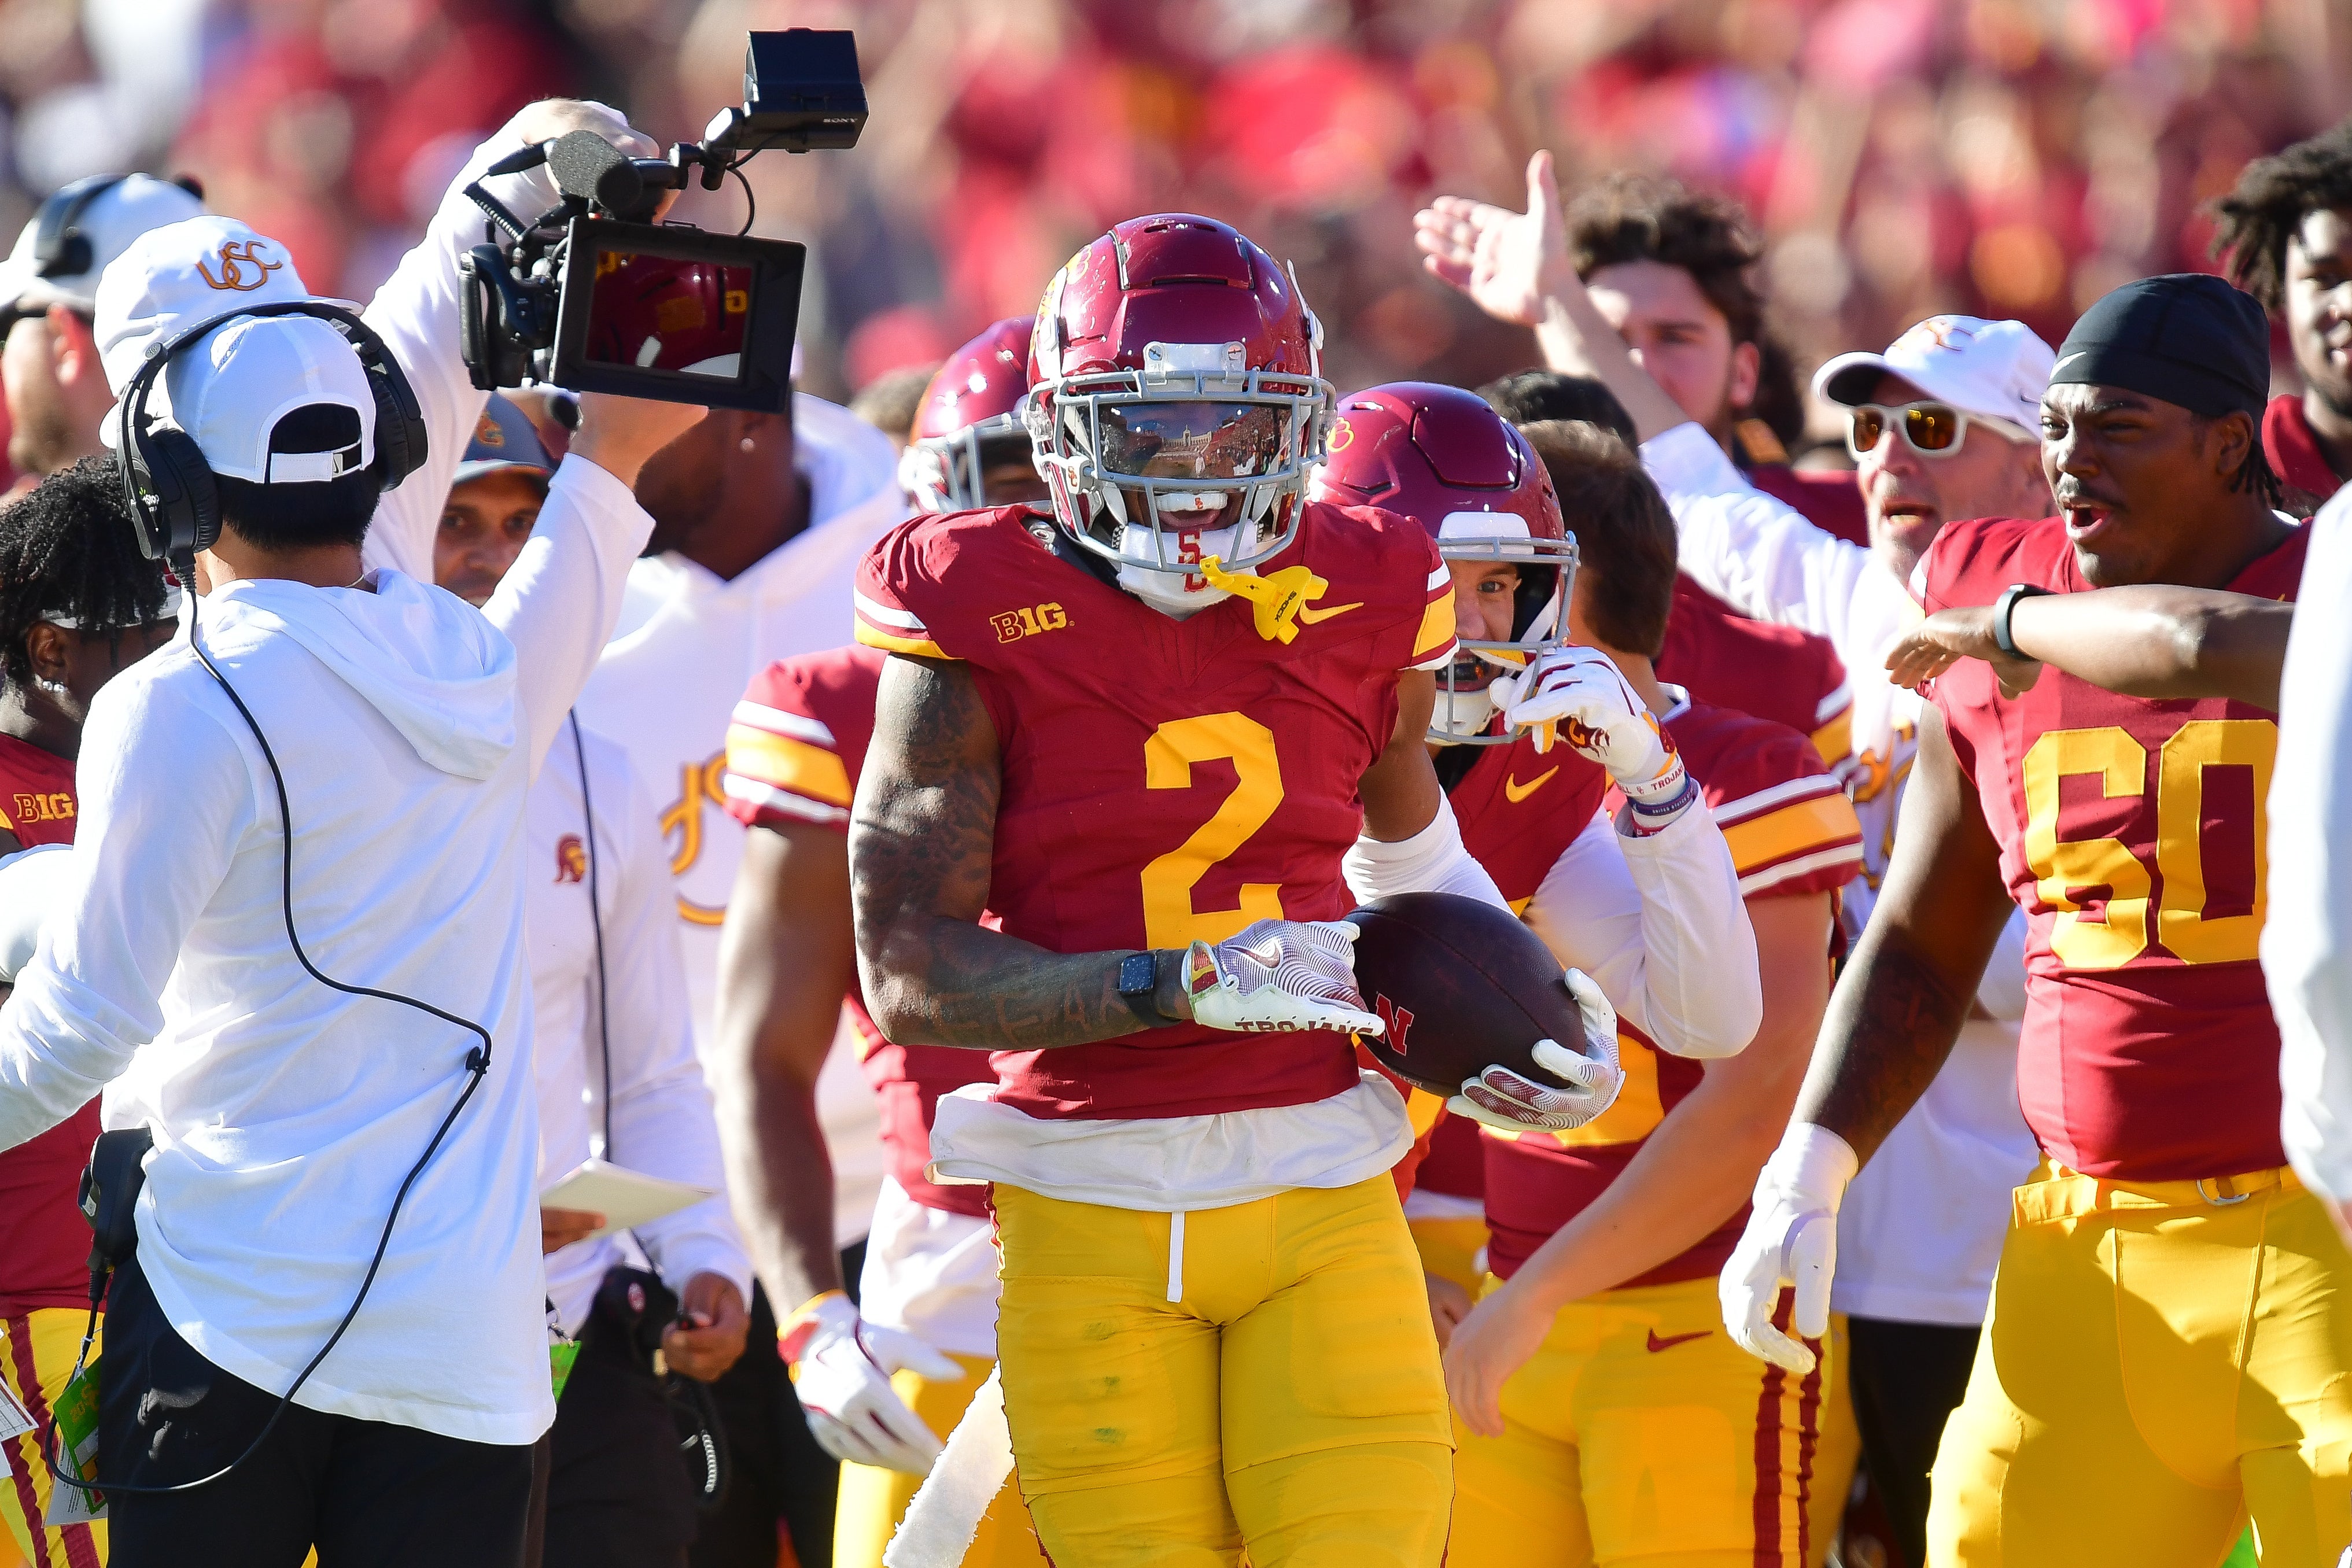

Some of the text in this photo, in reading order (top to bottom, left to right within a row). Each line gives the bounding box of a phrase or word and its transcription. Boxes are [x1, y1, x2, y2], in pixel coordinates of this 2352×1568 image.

[196, 241, 283, 291] USC
[1274, 590, 1297, 622] SHOCK
[1141, 711, 1284, 949] 2
[2022, 719, 2279, 969] 60
[1374, 994, 1415, 1057] N
